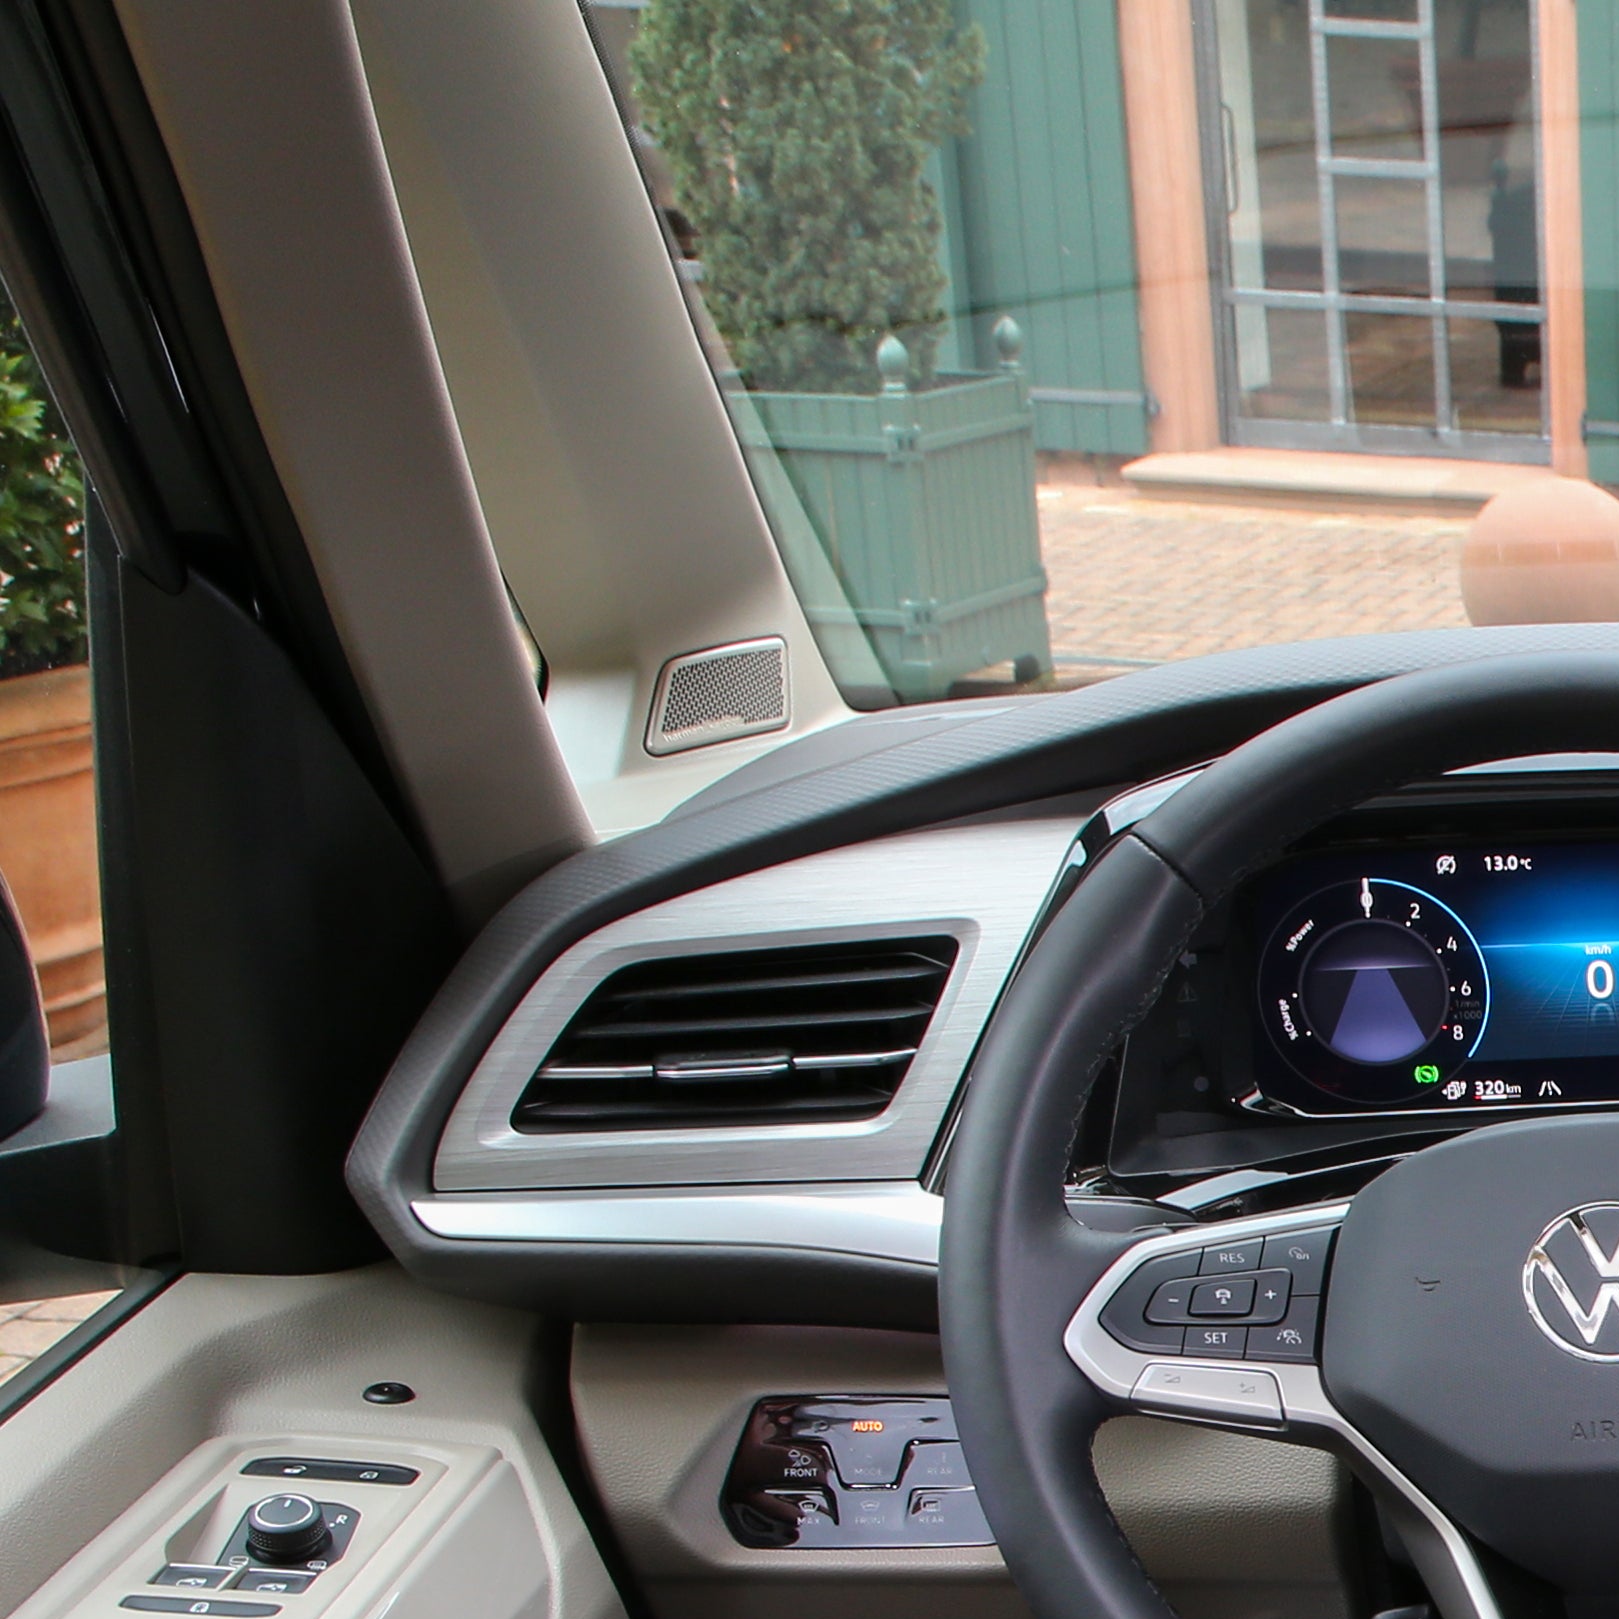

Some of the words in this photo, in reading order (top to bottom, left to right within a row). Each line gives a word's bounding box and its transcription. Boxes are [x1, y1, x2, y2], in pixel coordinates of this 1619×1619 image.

[1409, 902, 1421, 920] 2
[1446, 935, 1458, 952] 4
[1584, 944, 1613, 956] km/h
[1586, 959, 1615, 999] 0
[1460, 980, 1472, 996] 6
[1453, 1024, 1465, 1041] 8
[1219, 1252, 1245, 1264] RES
[1204, 1331, 1229, 1345] SET
[852, 1420, 884, 1432] AUTO
[784, 1467, 818, 1478] FRONT
[335, 1513, 349, 1526] R
[796, 1516, 821, 1526] MAX
